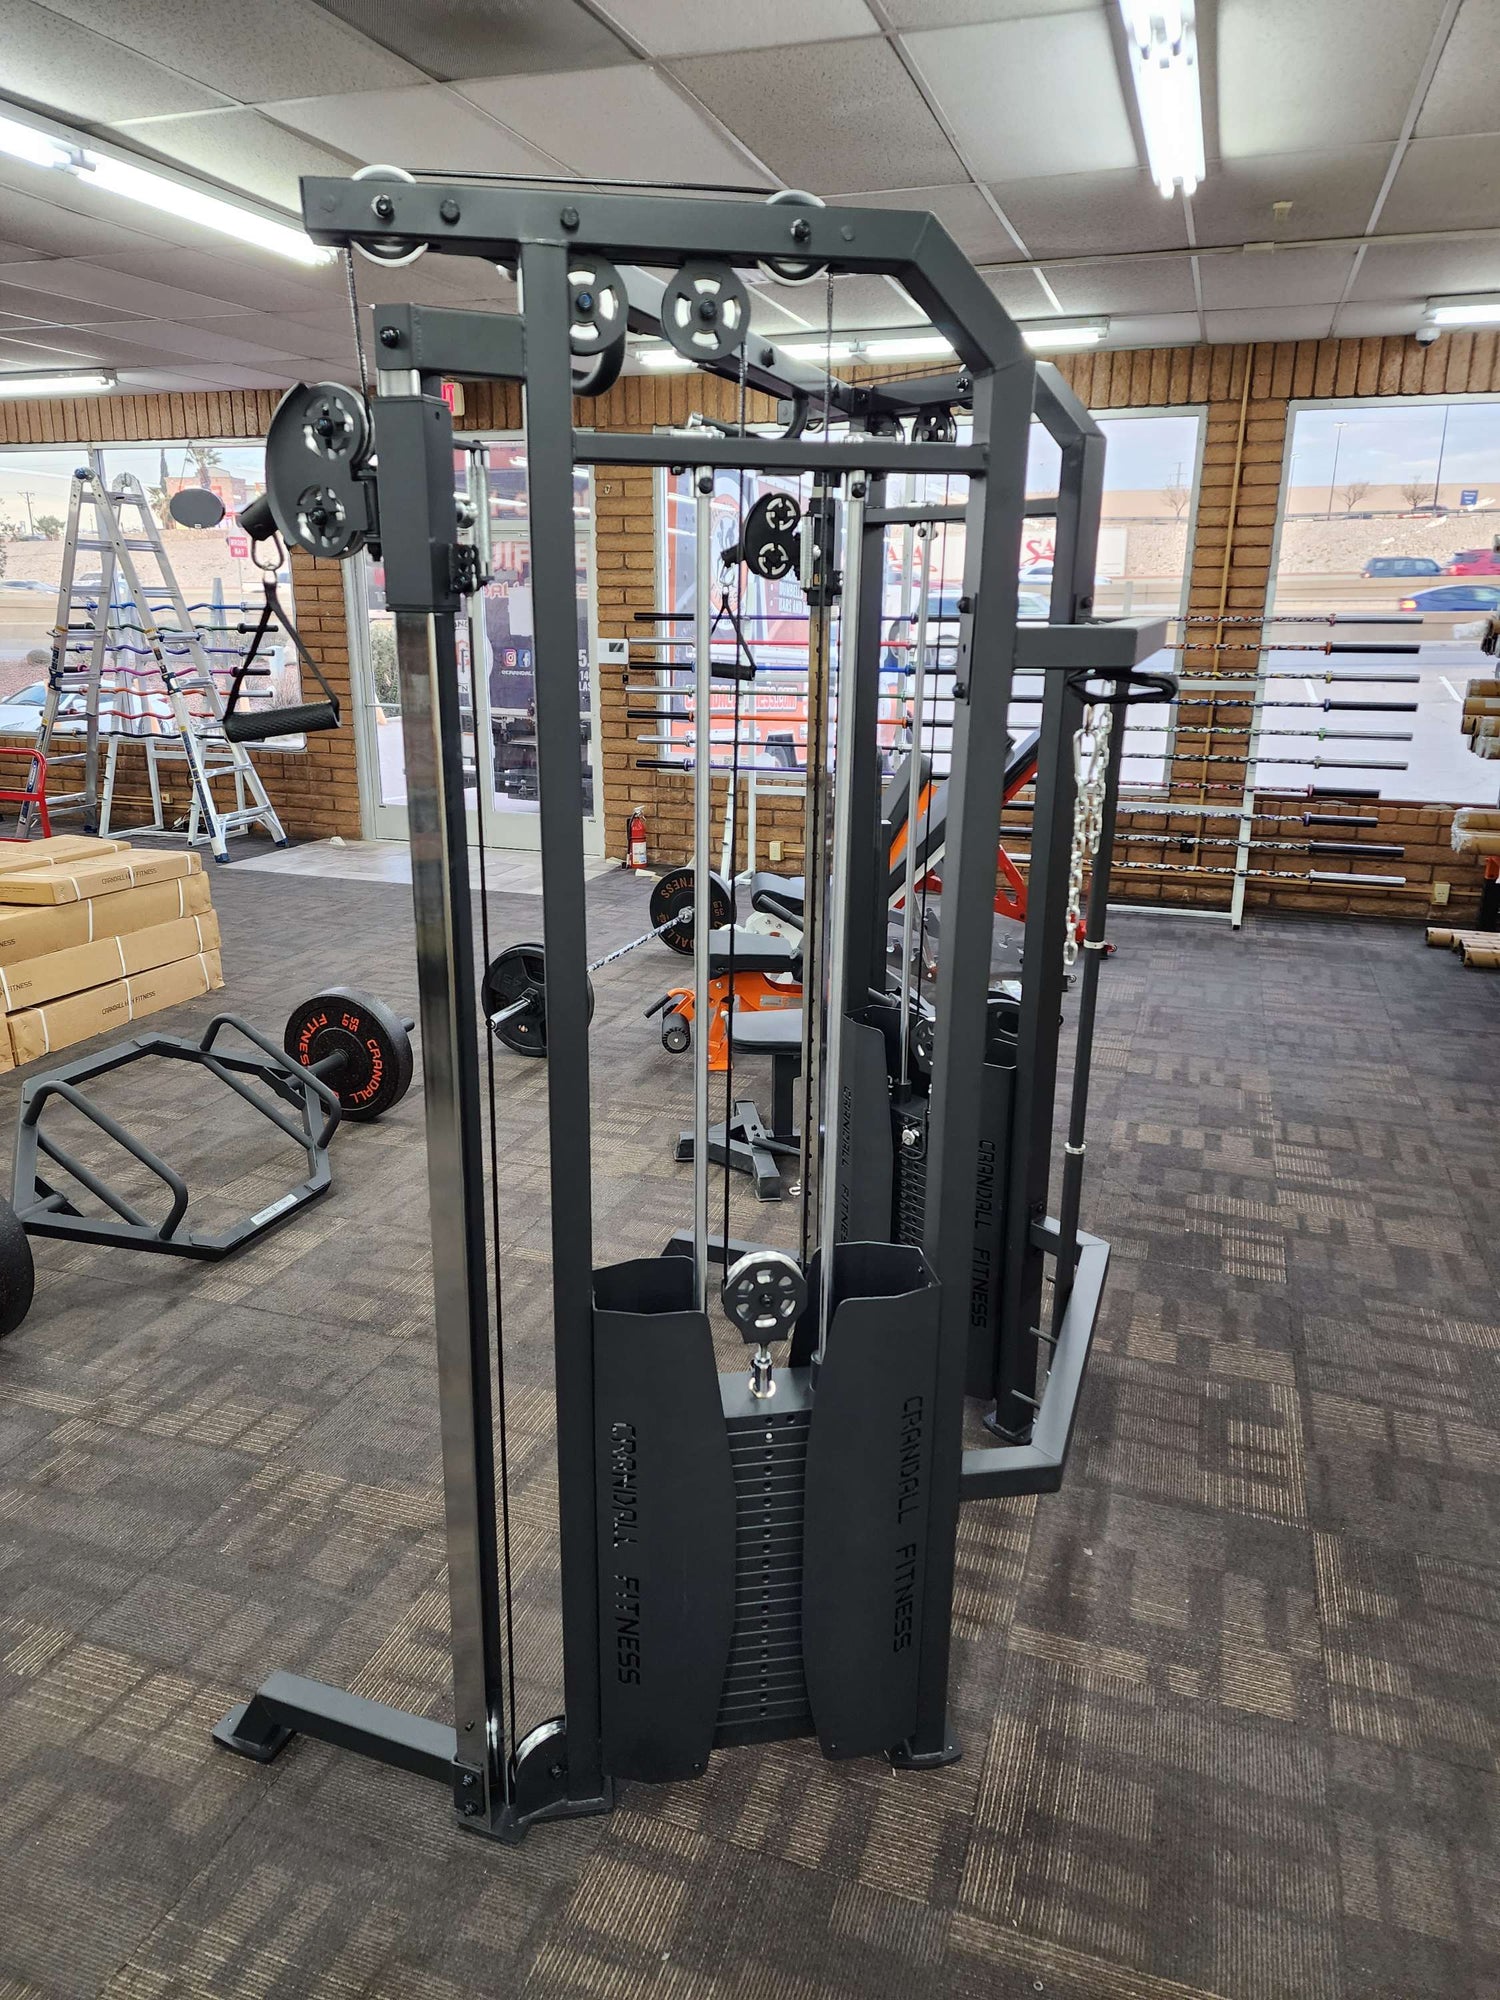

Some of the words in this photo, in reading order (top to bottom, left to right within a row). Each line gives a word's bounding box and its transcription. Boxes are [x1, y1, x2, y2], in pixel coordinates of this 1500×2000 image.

[135, 990, 156, 1003] FITNESS
[341, 1013, 351, 1027] LB
[348, 1016, 360, 1032] 55
[298, 1013, 328, 1067] FITNES
[349, 1039, 383, 1103] CRANDALL
[974, 1140, 996, 1229] CRANDALL
[970, 1247, 991, 1329] FITNESS
[611, 1422, 639, 1547] CRANDALL
[898, 1395, 925, 1525] CRANDALL
[613, 1574, 641, 1687] FITNESS
[893, 1543, 917, 1653] FITNESS
